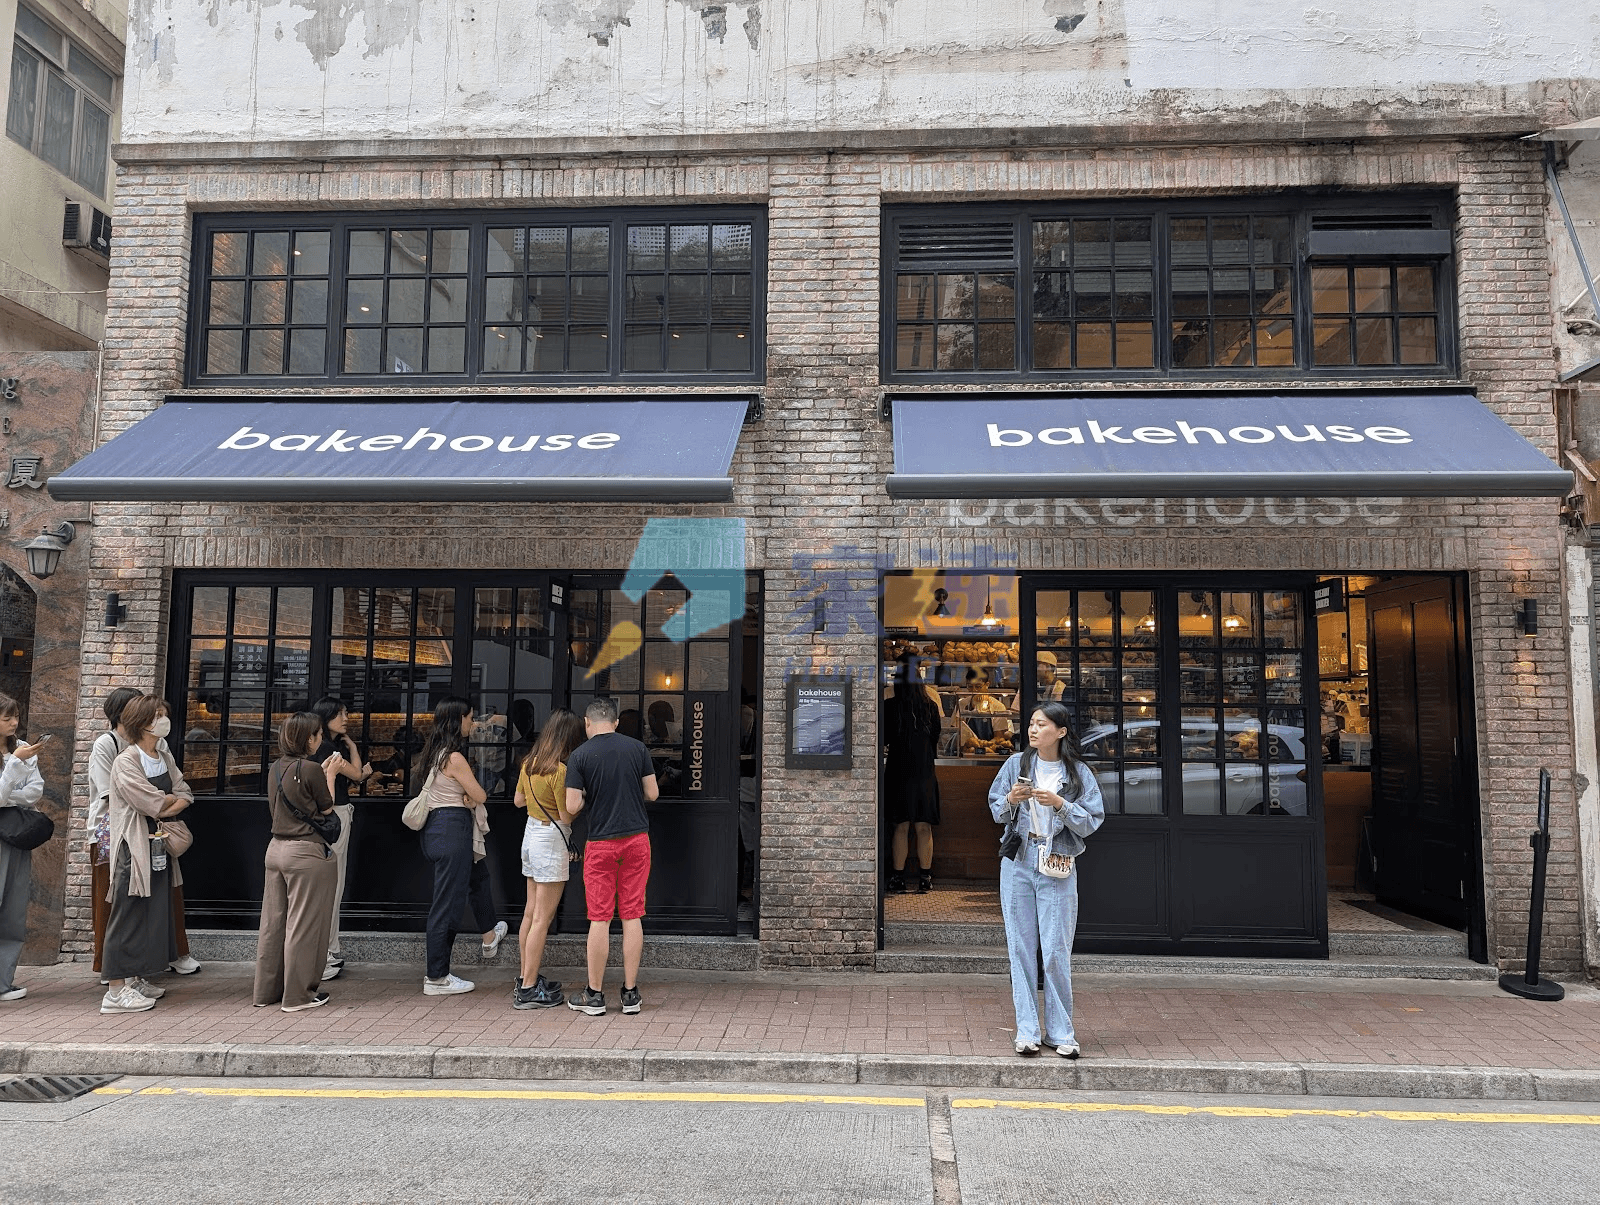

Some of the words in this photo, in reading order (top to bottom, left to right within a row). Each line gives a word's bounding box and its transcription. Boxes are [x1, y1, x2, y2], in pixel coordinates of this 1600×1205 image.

[217, 426, 621, 453] bakehouse
[986, 420, 1413, 447] bakehouse
[798, 688, 842, 697] bakehouse
[688, 701, 704, 791] bakehouse
